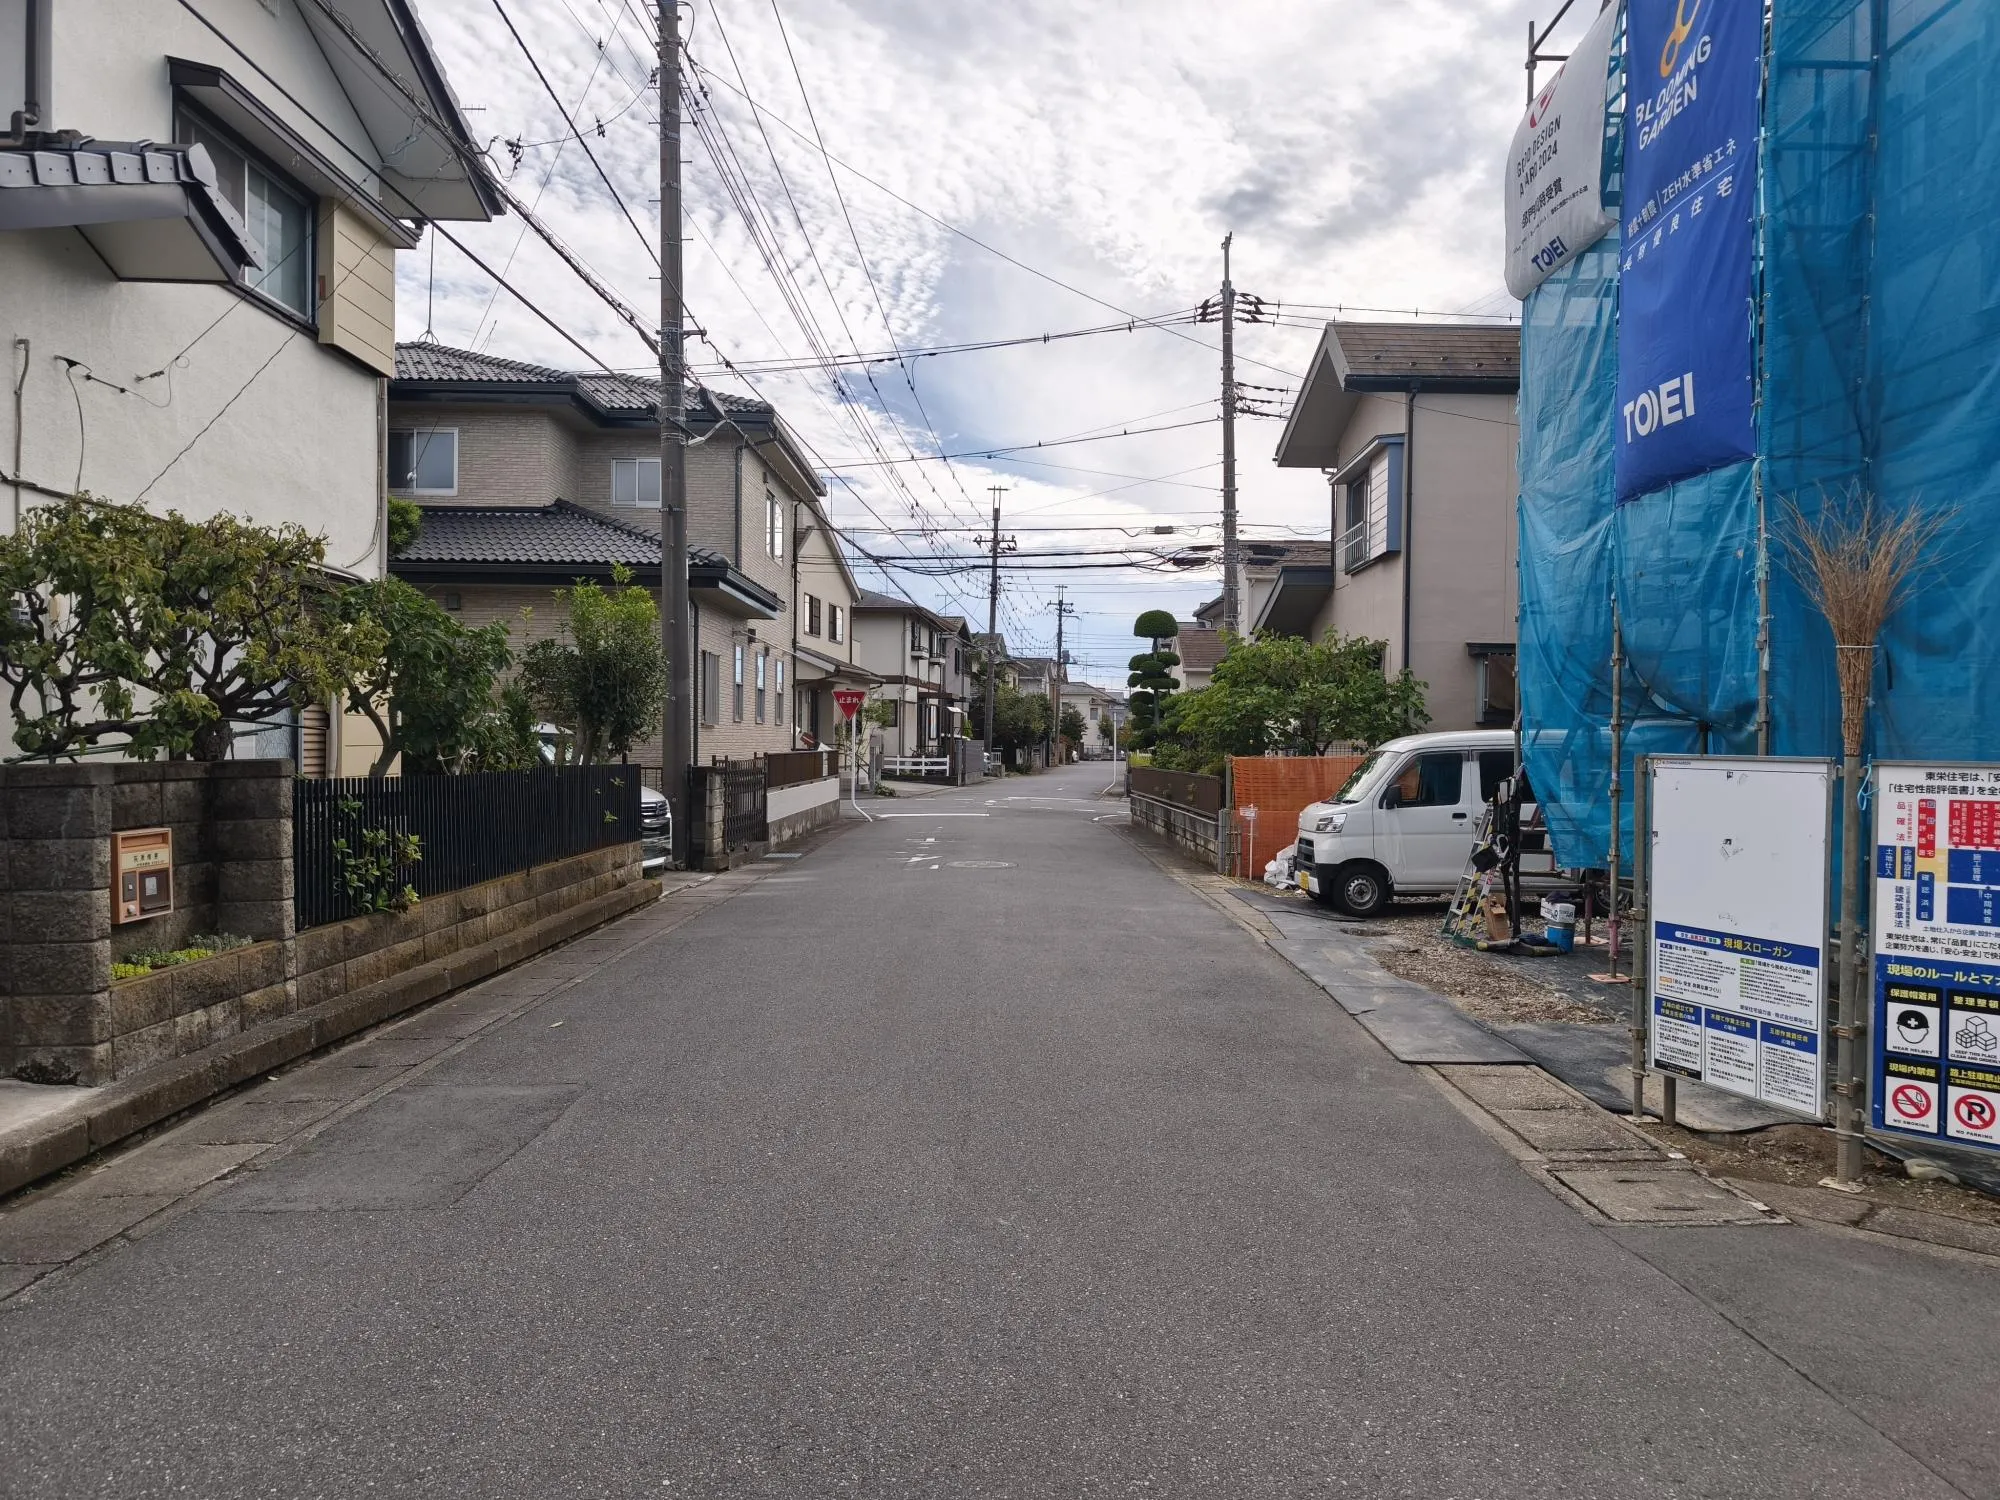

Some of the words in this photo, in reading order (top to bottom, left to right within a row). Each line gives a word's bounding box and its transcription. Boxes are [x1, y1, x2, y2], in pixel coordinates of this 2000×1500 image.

[1636, 35, 1713, 127] BLOOMING
[1639, 75, 1698, 151] GARDEN
[1532, 115, 1561, 156] DESIGN
[1539, 140, 1558, 170] 2024
[1662, 139, 1737, 205] ZEH水準省エネ
[1531, 235, 1569, 272] TOEI
[1623, 372, 1696, 444] TOEI
[1888, 783, 2000, 796] 「住宅性能評価書」を全
[1984, 893, 1992, 924] 中間検査
[1724, 937, 1793, 958] 現場スローガン
[1890, 988, 1936, 1002] 保護帽着用
[1954, 996, 1999, 1009] 整理整頓
[1889, 1062, 1936, 1077] 現場内禁煙
[1903, 1120, 1930, 1128] SMOKING
[1966, 1132, 1993, 1140] PARKING
